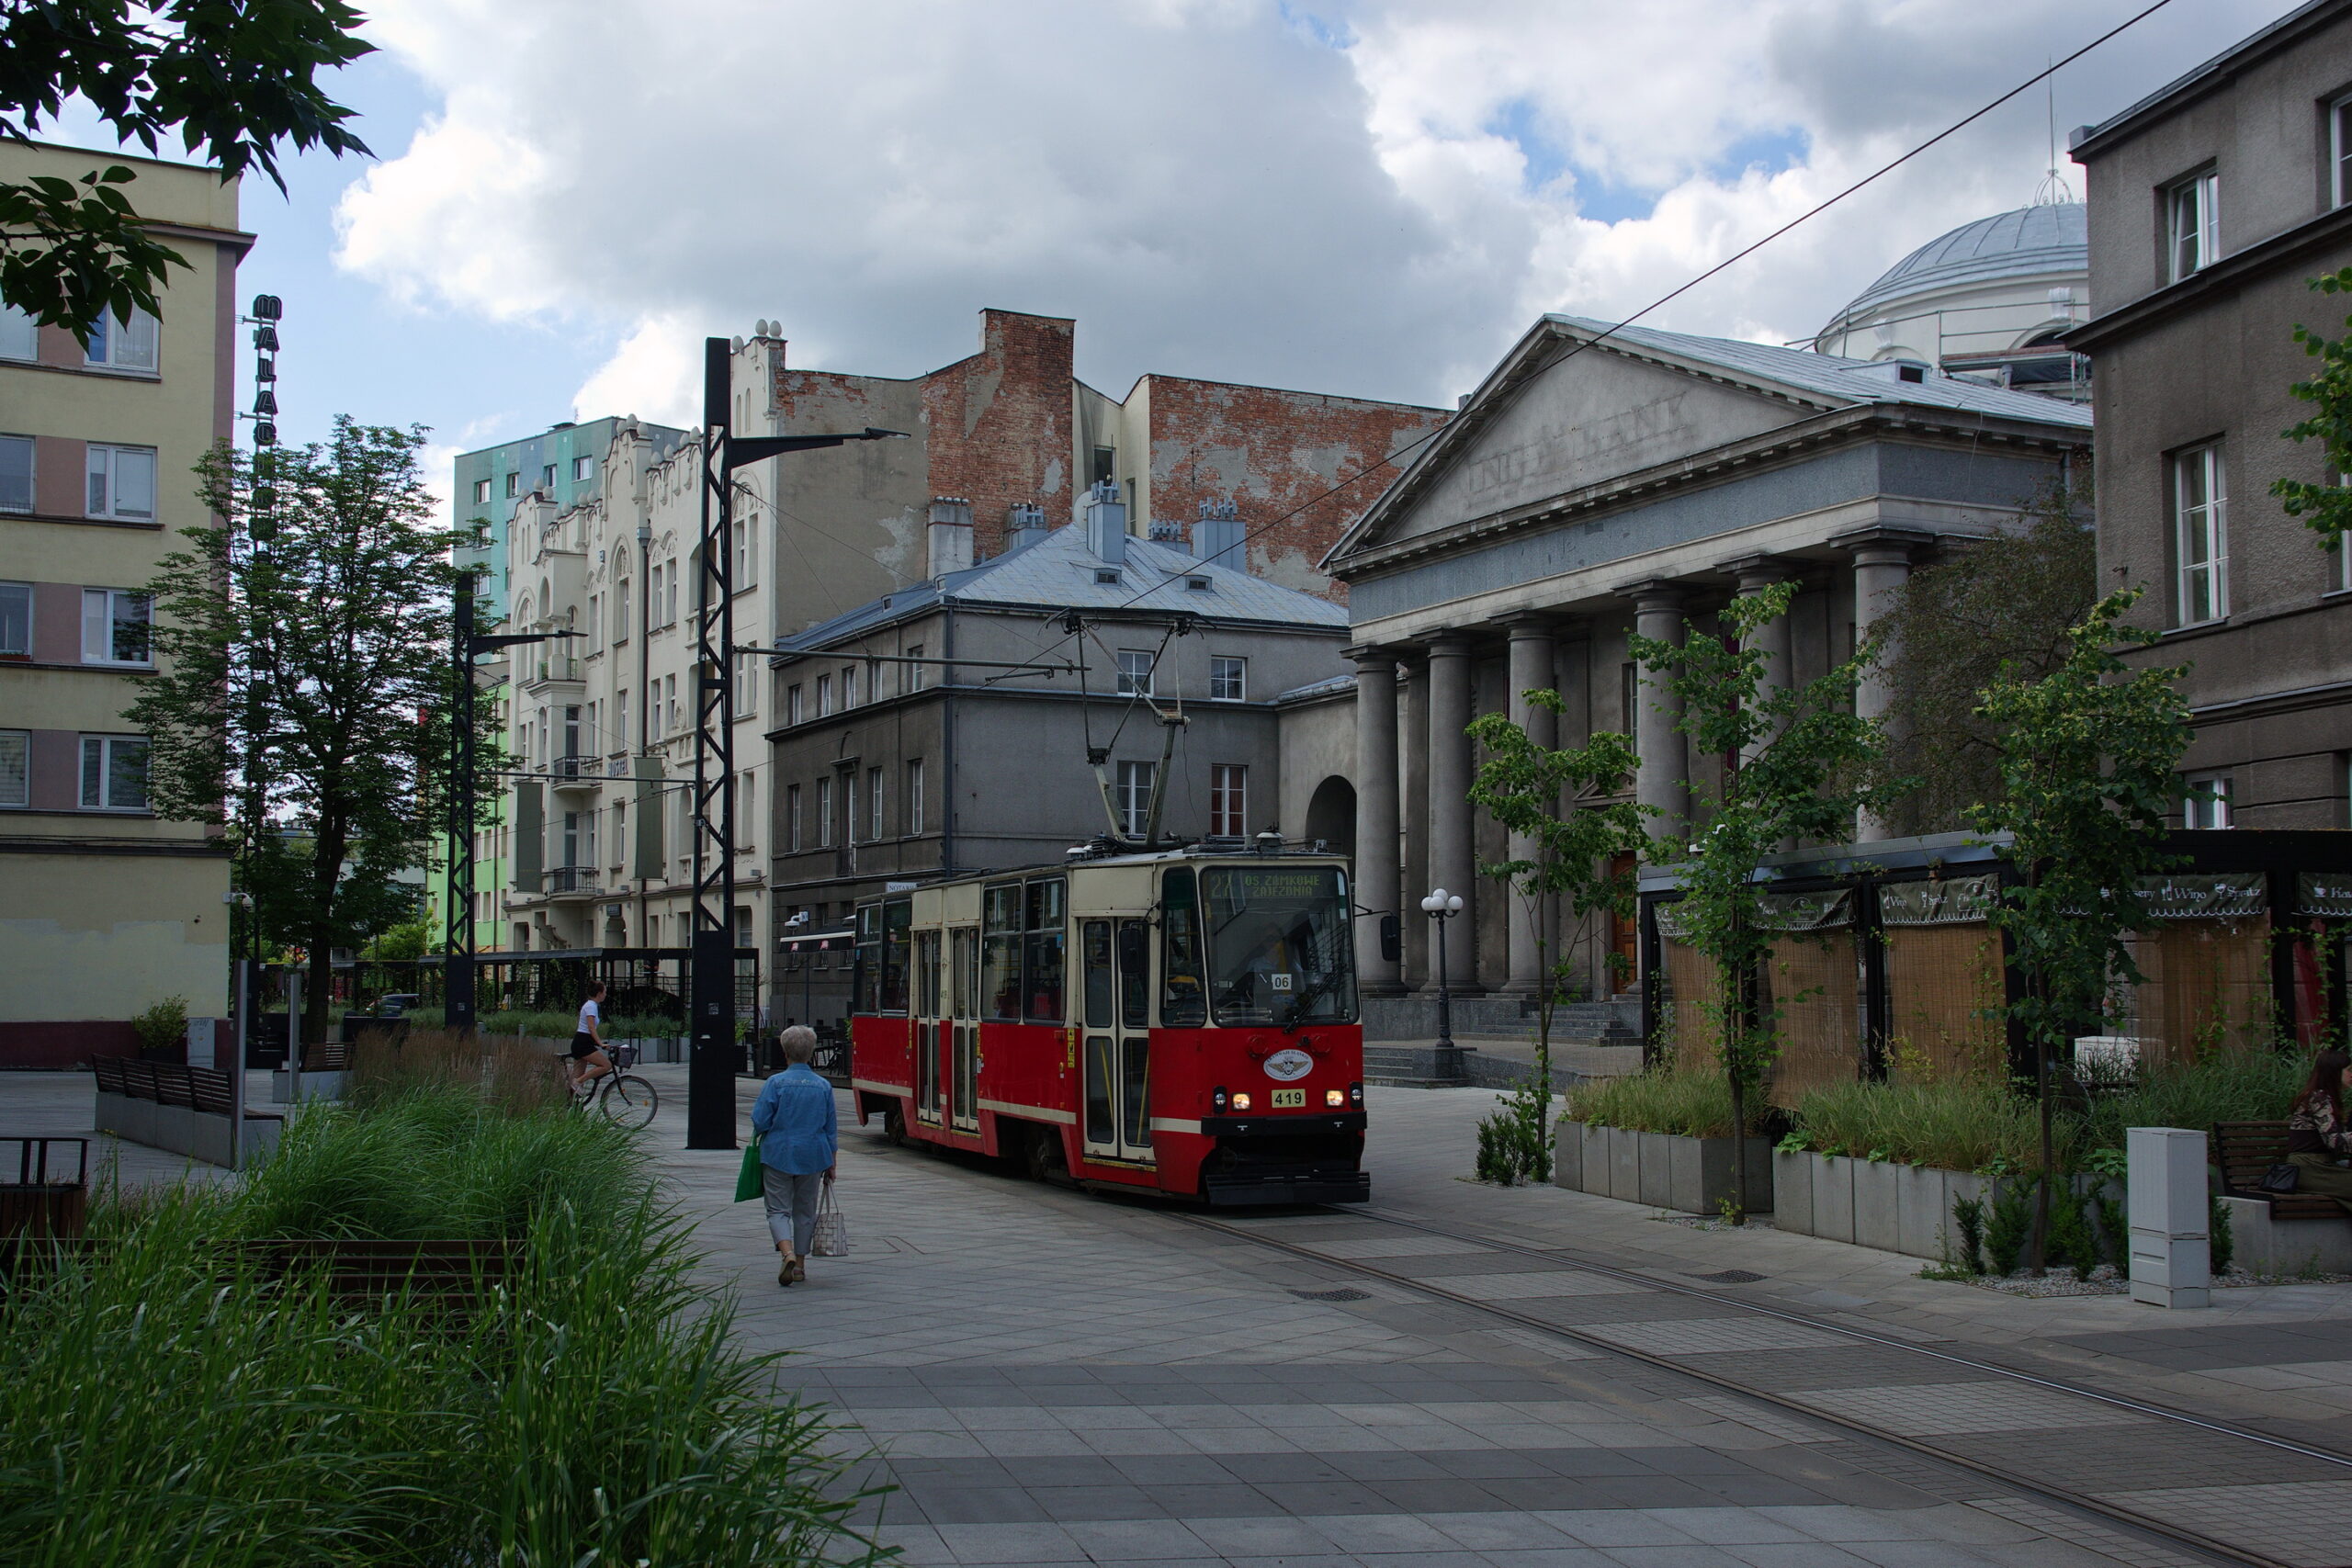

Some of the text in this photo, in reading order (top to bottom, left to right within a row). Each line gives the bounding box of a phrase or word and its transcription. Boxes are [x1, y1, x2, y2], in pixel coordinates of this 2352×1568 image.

[607, 758, 628, 777] HOSTEL
[1264, 874, 1320, 886] ZAMKOWE
[1251, 886, 1313, 897] ZAJEZDNIA
[2174, 887, 2207, 903] Wino
[1274, 976, 1289, 988] 06
[1274, 1091, 1302, 1105] 419
